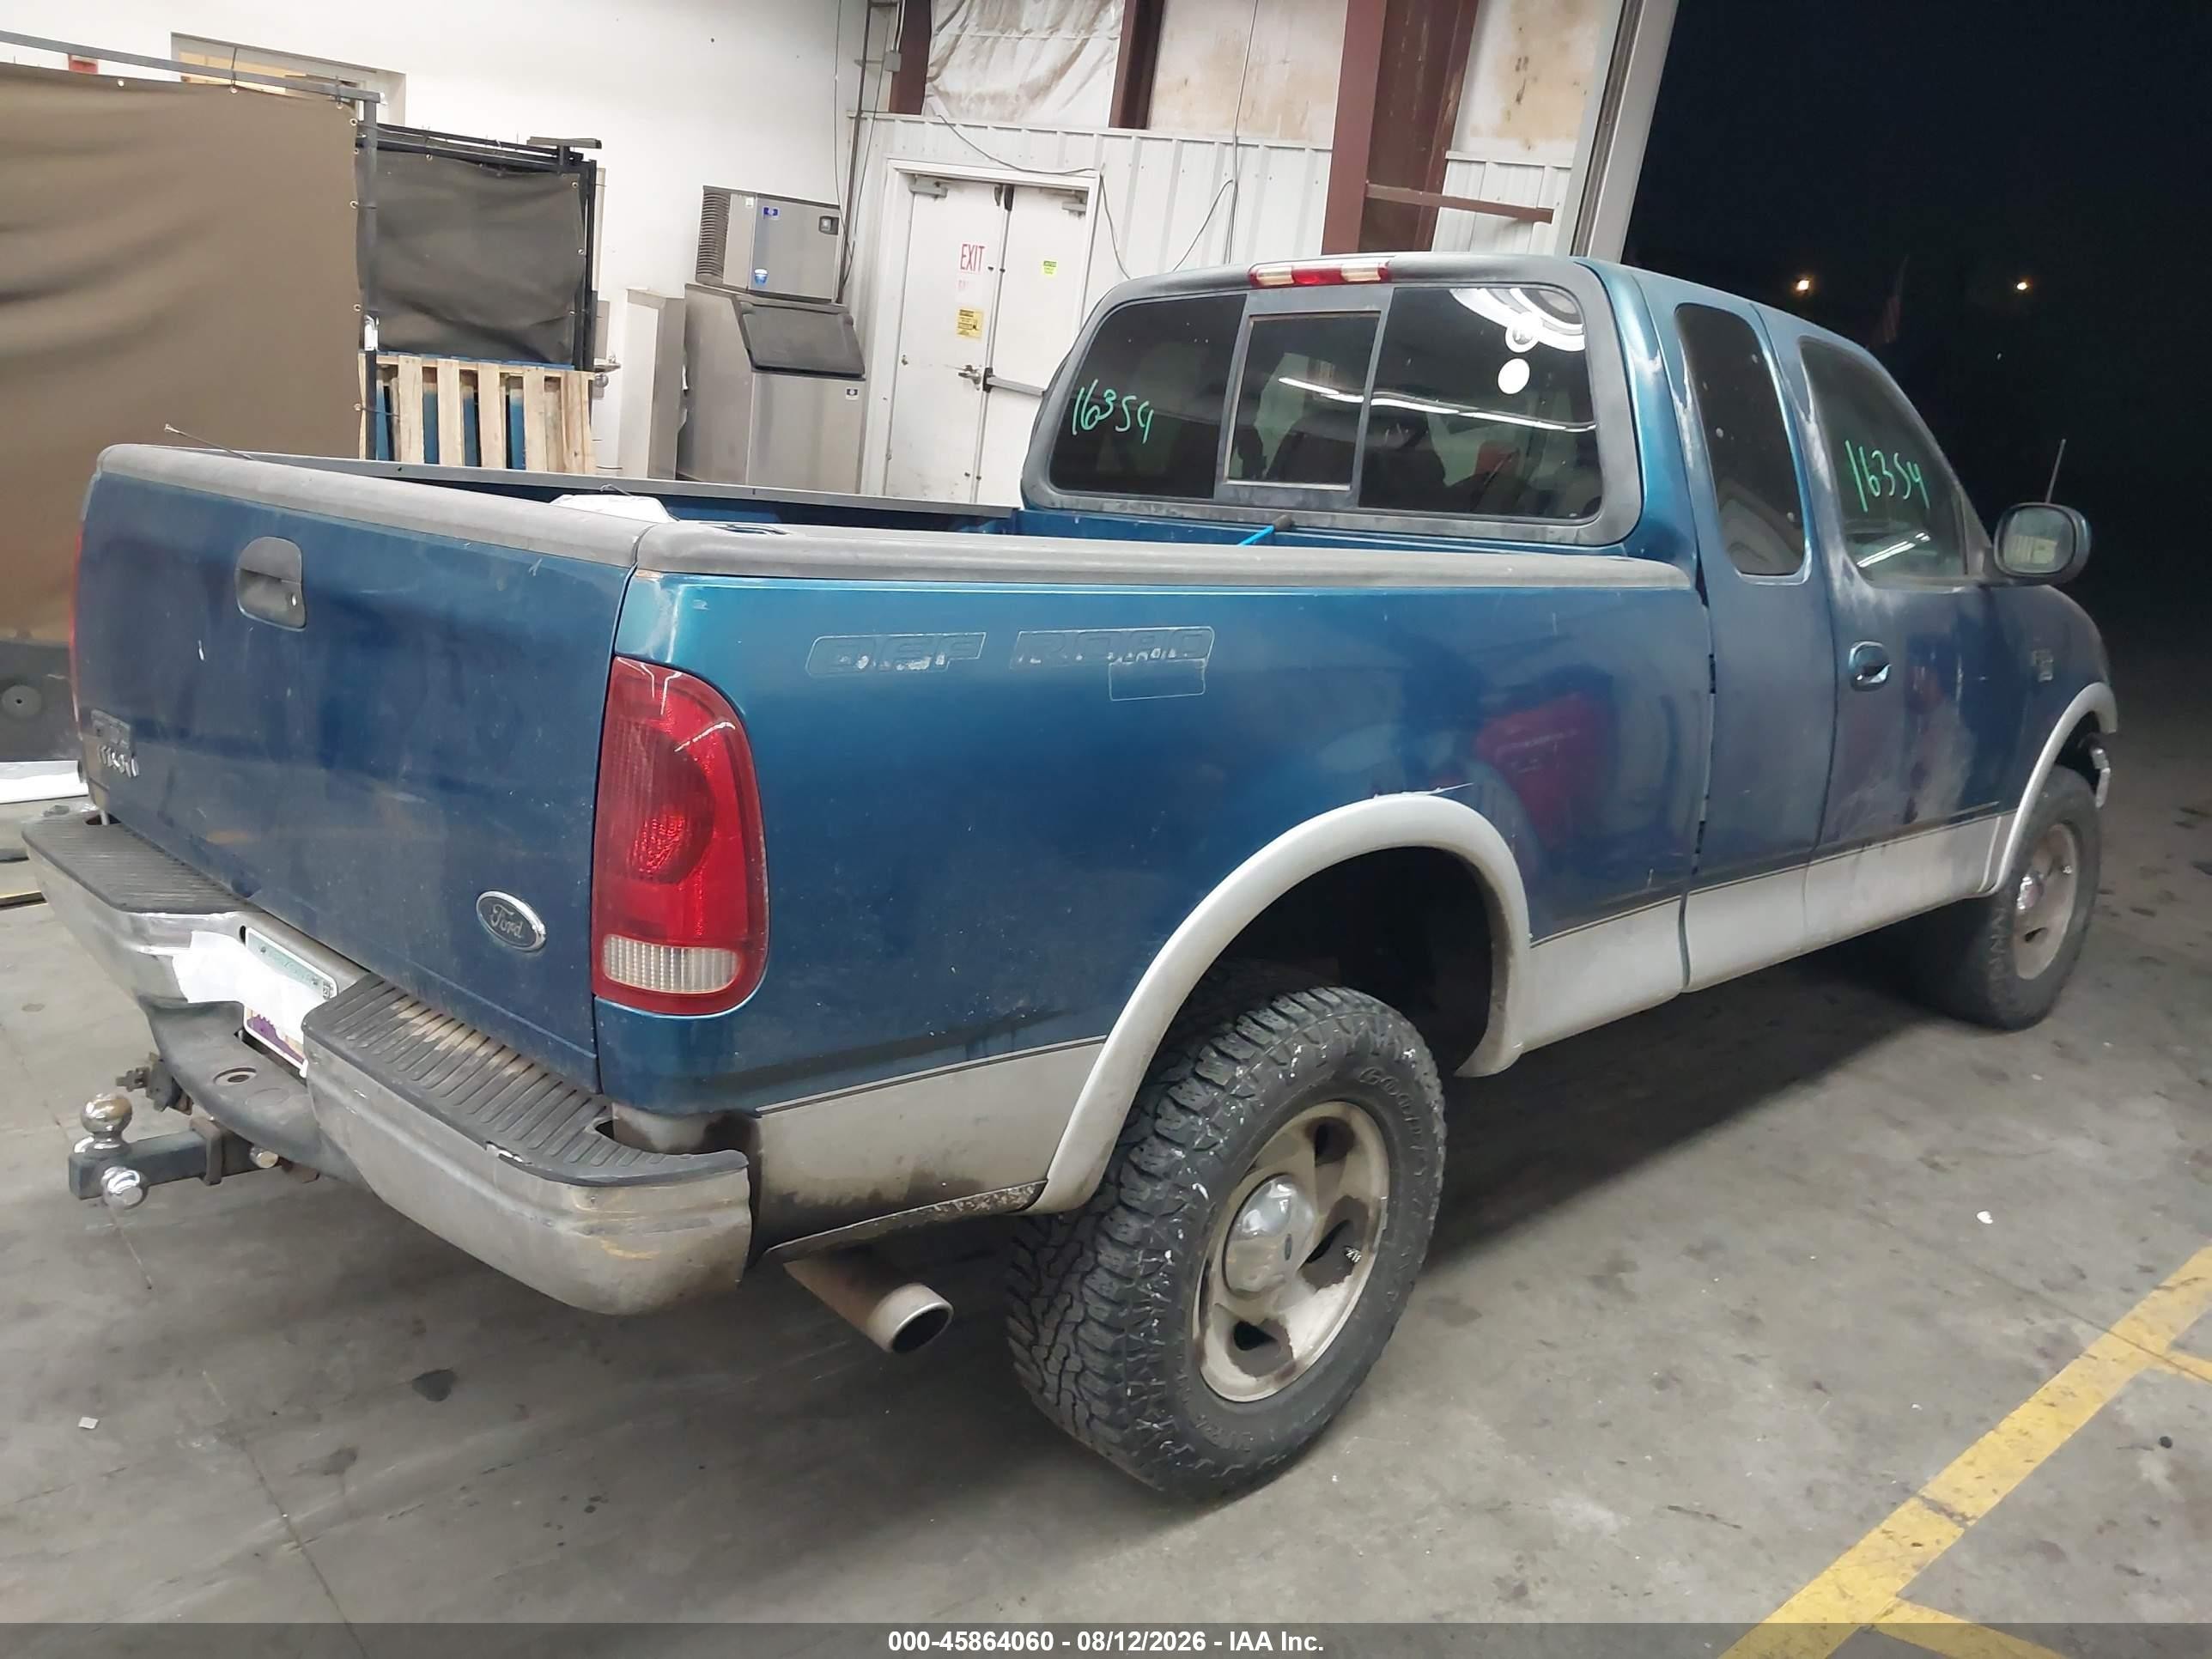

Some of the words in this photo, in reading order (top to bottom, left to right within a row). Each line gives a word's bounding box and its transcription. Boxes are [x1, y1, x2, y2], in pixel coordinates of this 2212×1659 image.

[960, 243, 985, 272] EXIT
[1844, 439, 1930, 513] 16354
[489, 903, 524, 939] Ford
